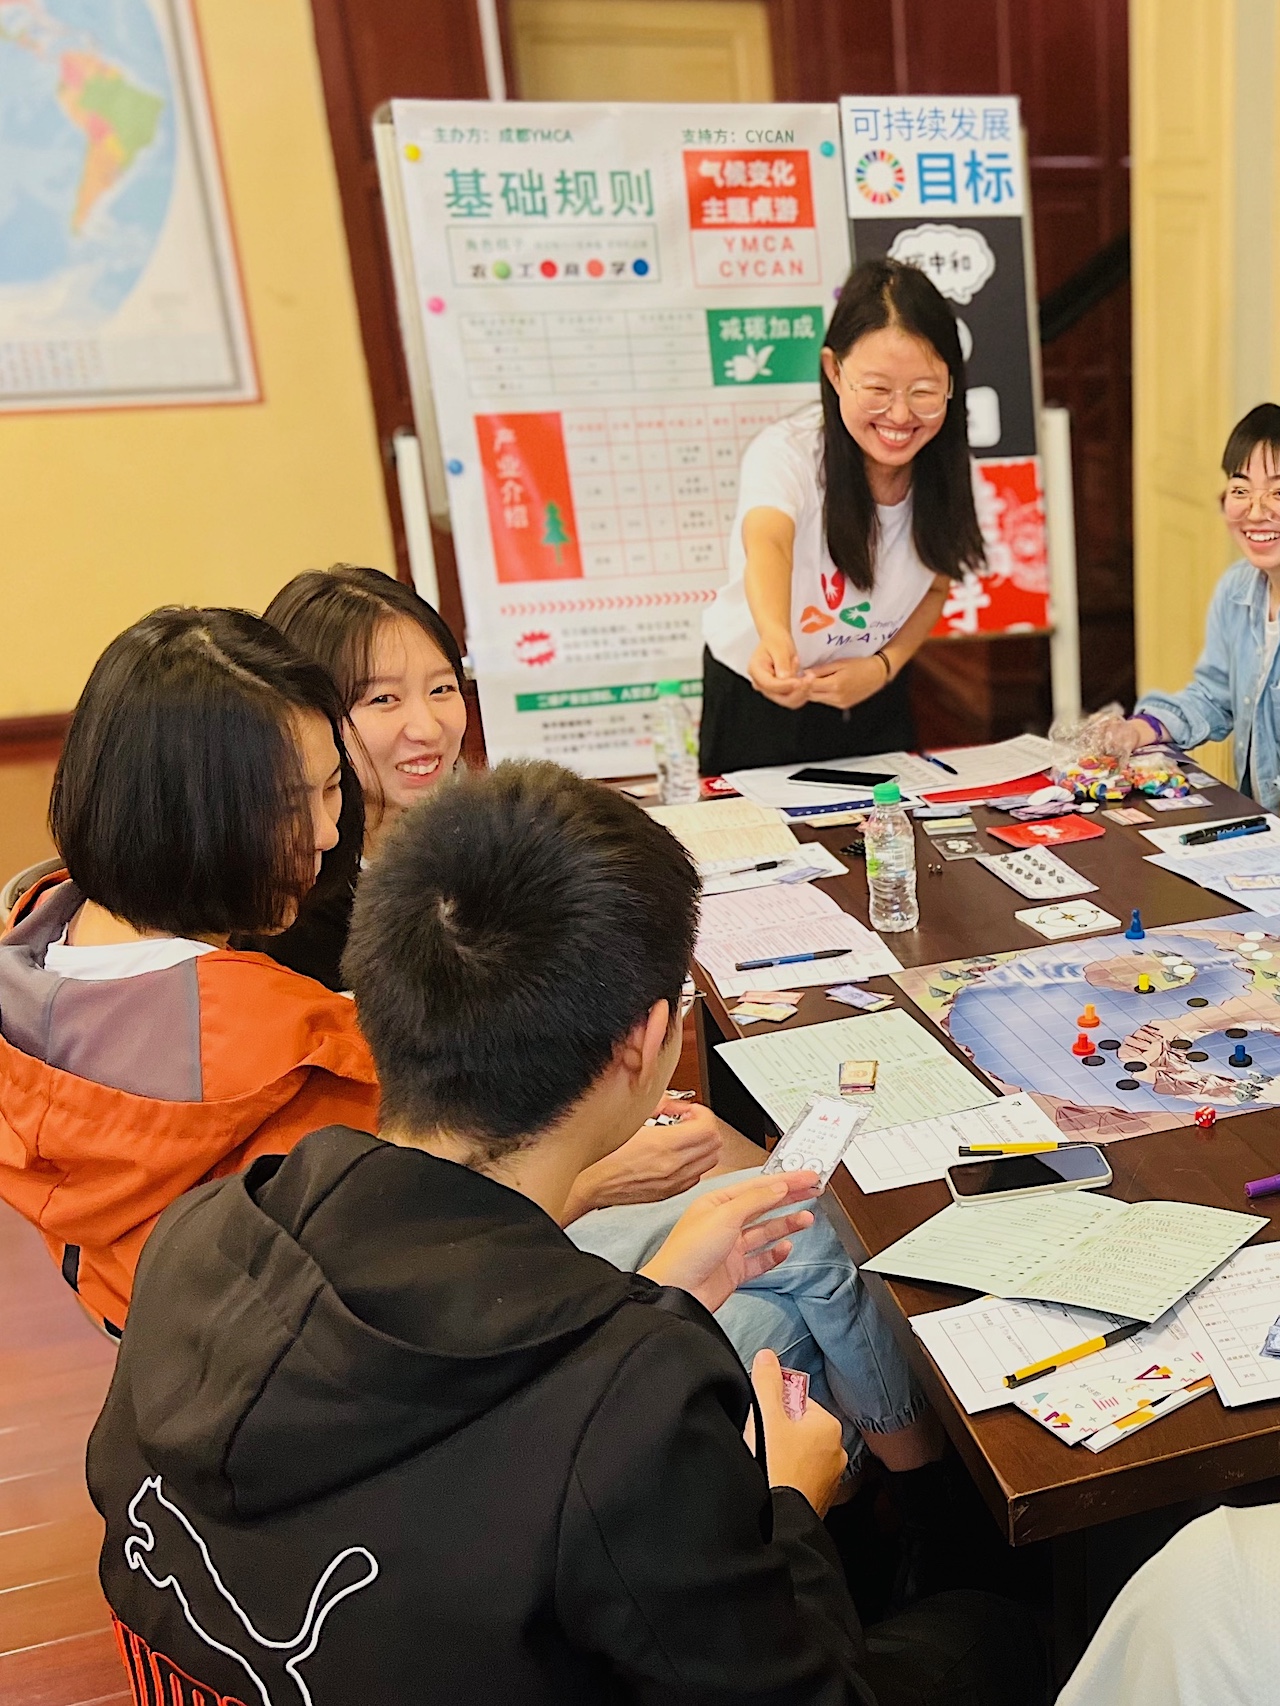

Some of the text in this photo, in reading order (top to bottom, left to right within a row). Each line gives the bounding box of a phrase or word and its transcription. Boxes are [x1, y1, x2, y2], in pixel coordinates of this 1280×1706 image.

[850, 107, 1012, 142] 可持续发展
[445, 168, 656, 218] 基础规则
[917, 150, 1015, 205] 目标
[723, 235, 795, 253] YMCA
[719, 260, 804, 277] CYCAN
